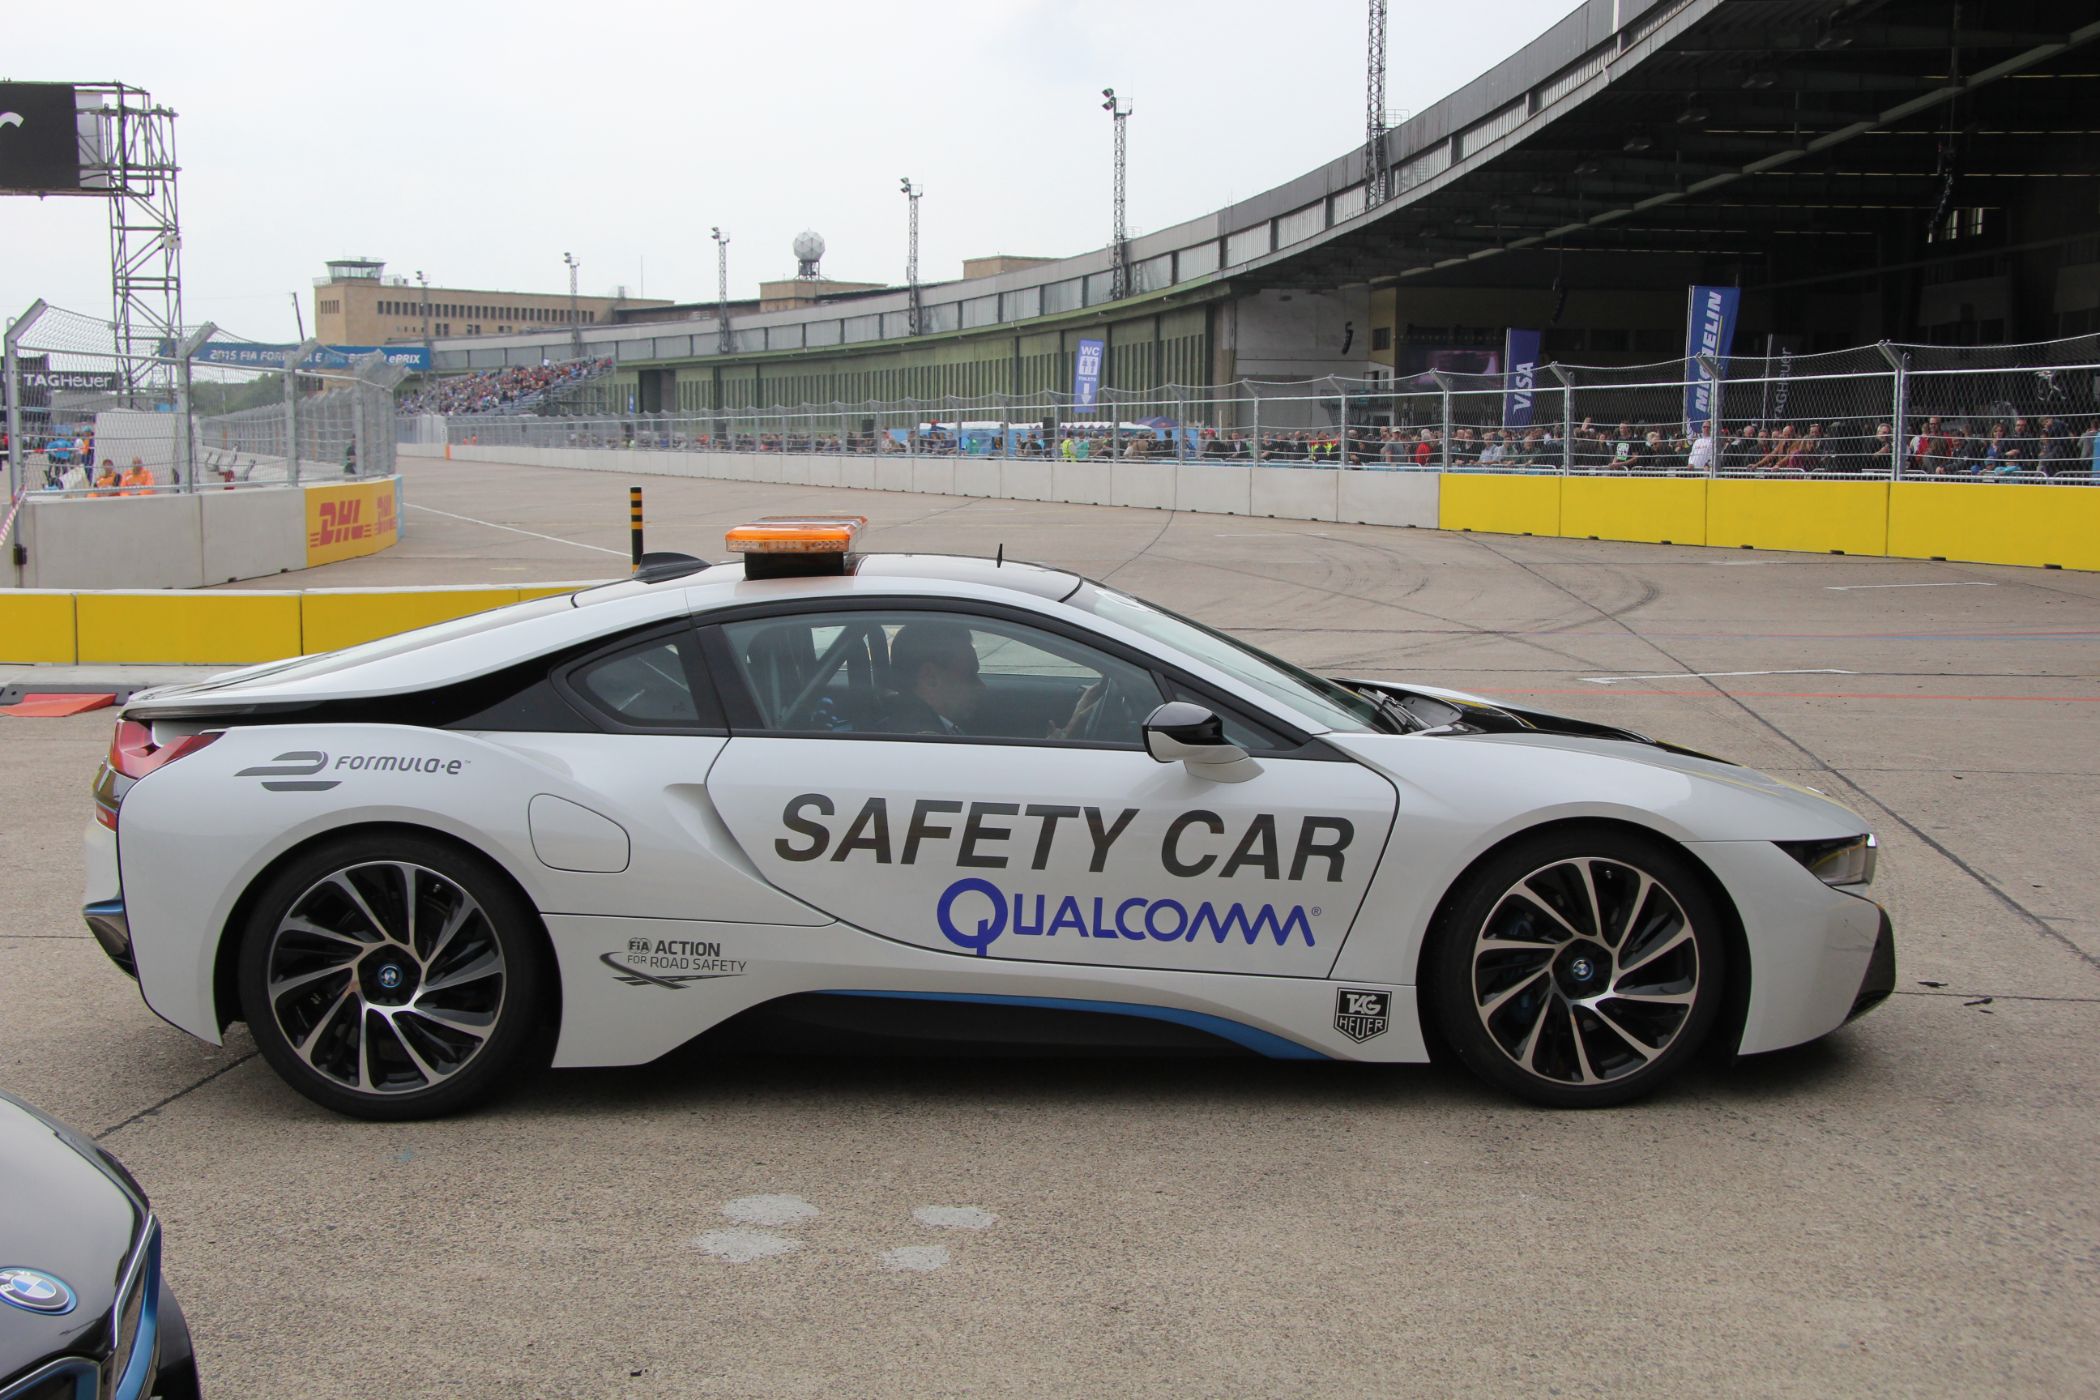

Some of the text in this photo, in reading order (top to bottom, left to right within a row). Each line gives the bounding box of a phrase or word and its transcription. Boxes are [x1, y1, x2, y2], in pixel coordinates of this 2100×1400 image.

[210, 350, 237, 361] 2015
[240, 351, 257, 362] FIA
[260, 351, 313, 363] FORA
[315, 353, 323, 363] E
[388, 355, 420, 364] ePRIX
[1081, 345, 1100, 356] WC
[1513, 362, 1533, 415] VISA
[319, 499, 364, 545] DHL
[774, 792, 1355, 882] SAFETY CAR
[655, 940, 720, 957] ACTION
[627, 955, 747, 972] FOR ROAD SAFETY
[1346, 993, 1381, 1015] TAG
[1339, 1016, 1383, 1037] HEUER
